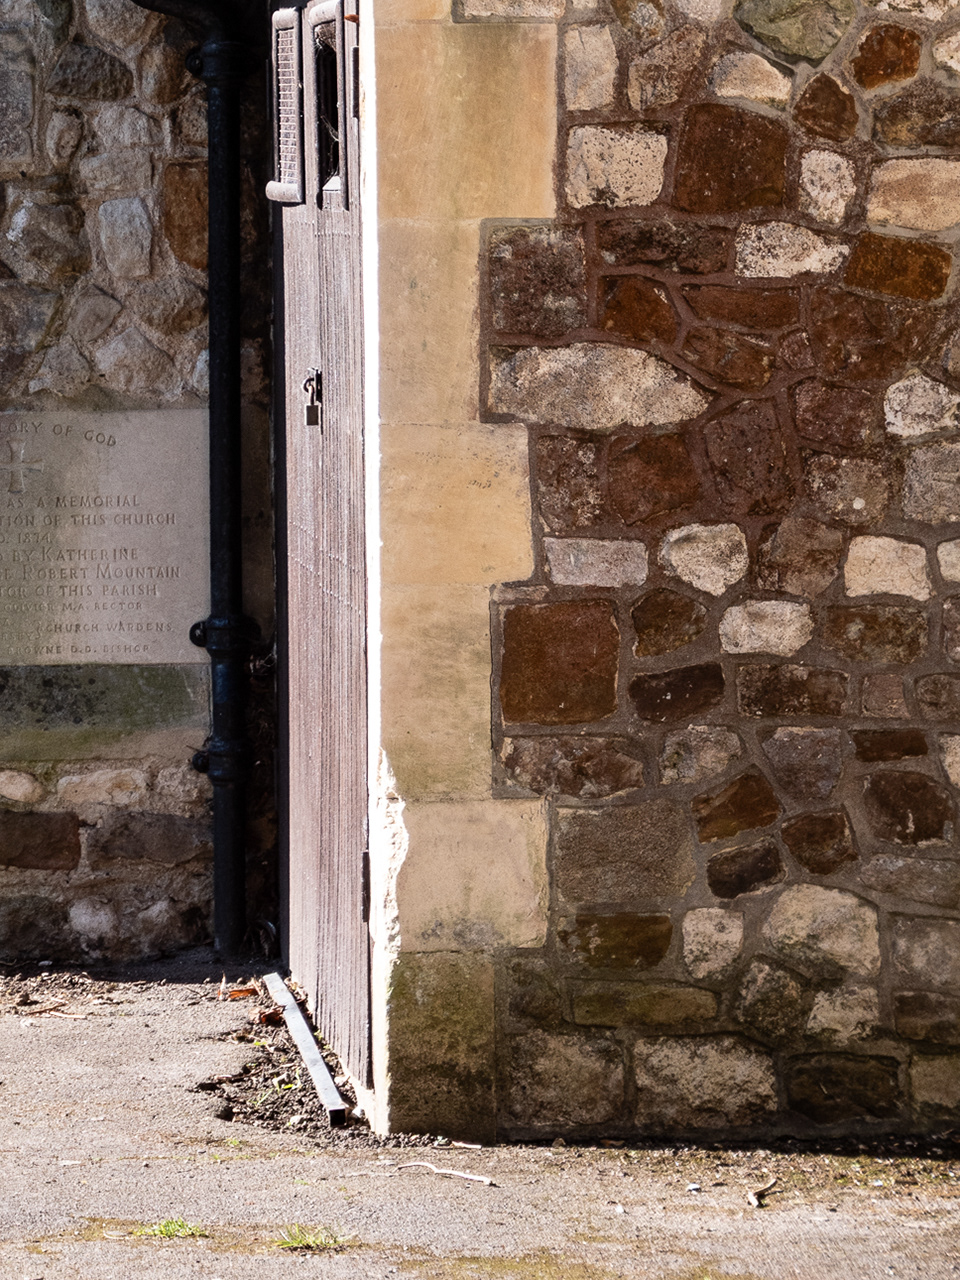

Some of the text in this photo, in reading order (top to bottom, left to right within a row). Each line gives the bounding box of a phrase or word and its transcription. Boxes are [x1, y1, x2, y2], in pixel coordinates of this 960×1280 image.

[51, 423, 73, 437] OF
[83, 429, 117, 448] GOD
[6, 496, 24, 509] AS
[37, 496, 46, 508] A
[55, 494, 141, 509] MEMORIAL
[43, 514, 61, 527] OF
[70, 513, 106, 526] THIS
[113, 512, 176, 526] CHURCH
[12, 549, 32, 563] BY
[41, 545, 139, 563] KATHERINE
[21, 563, 89, 581] ROBERT
[95, 562, 181, 581] MOUNTAIN
[34, 584, 53, 598] OF
[59, 584, 93, 597] THIS
[101, 583, 158, 597] PARISH
[94, 601, 143, 612] RECTOR
[46, 622, 99, 633] CHURCH
[103, 644, 150, 653] BISHOP
